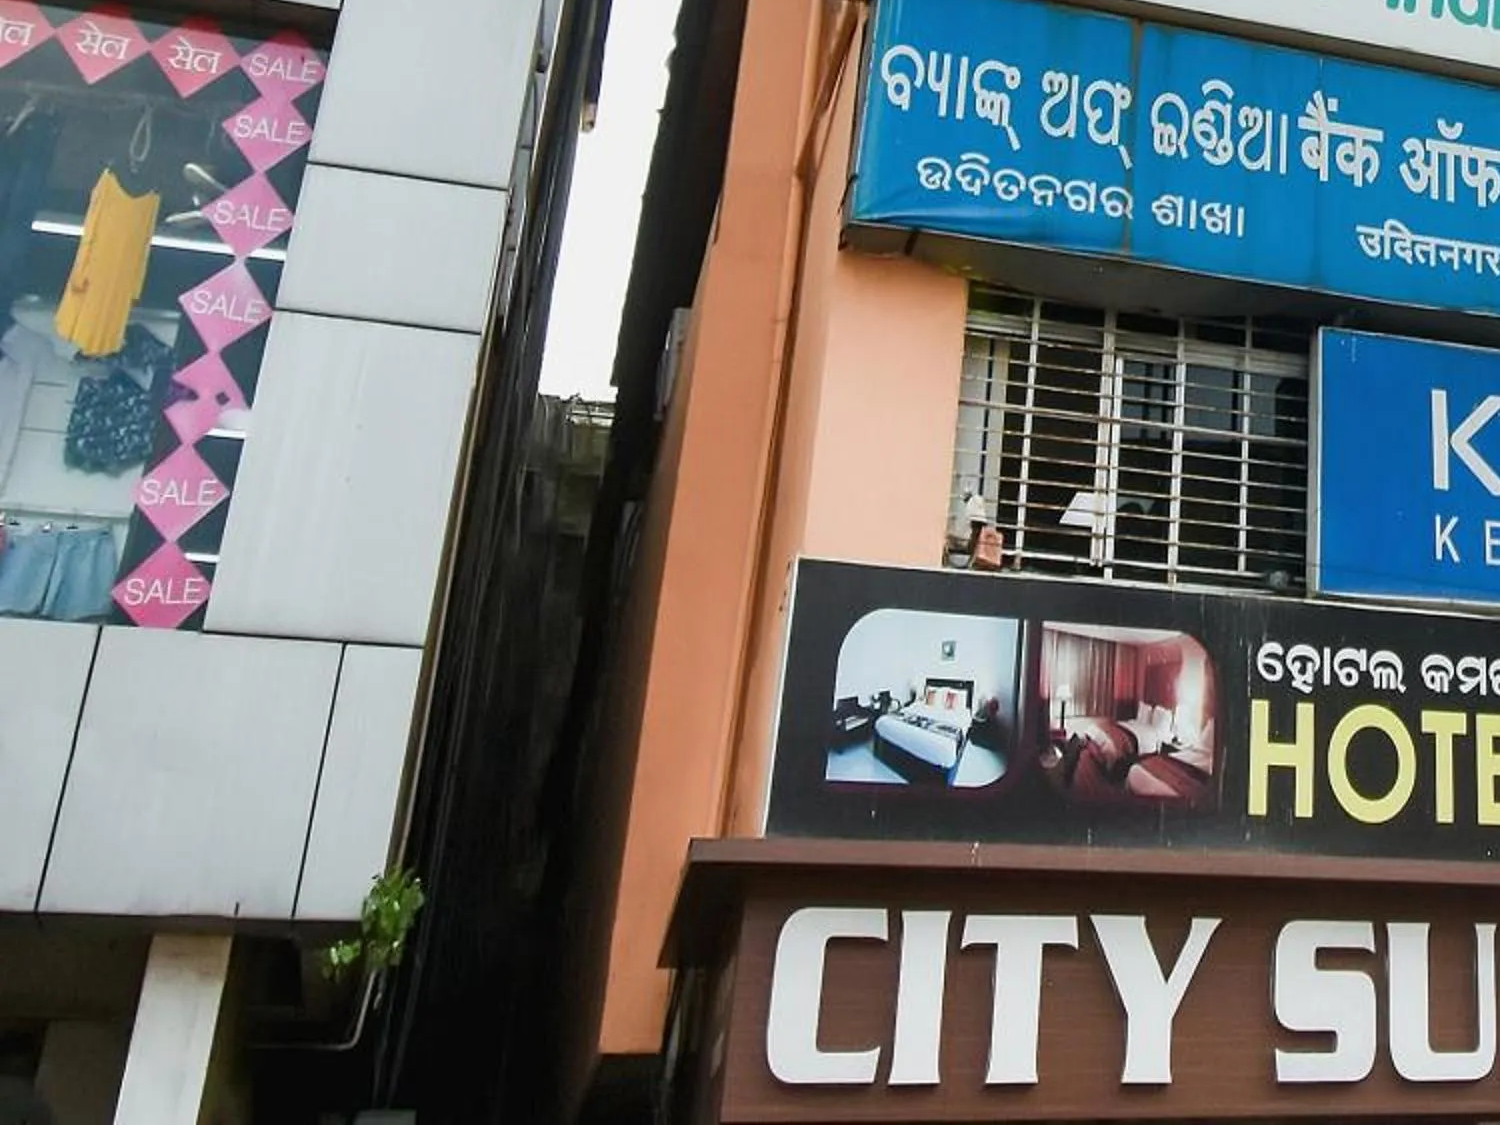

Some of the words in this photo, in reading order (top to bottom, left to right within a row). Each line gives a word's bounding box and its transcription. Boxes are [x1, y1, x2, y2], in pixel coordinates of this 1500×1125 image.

[76, 21, 132, 60] सेल
[168, 37, 222, 74] सेल
[249, 53, 322, 84] SALE
[232, 117, 306, 145] SALE
[1298, 90, 1385, 187] बैंक
[213, 200, 288, 233] SALE
[1151, 193, 1245, 237] ଶାଖା
[191, 291, 266, 323] SALE
[139, 477, 219, 507] SALE
[124, 577, 204, 607] SALE
[765, 906, 1222, 1085] CITY
